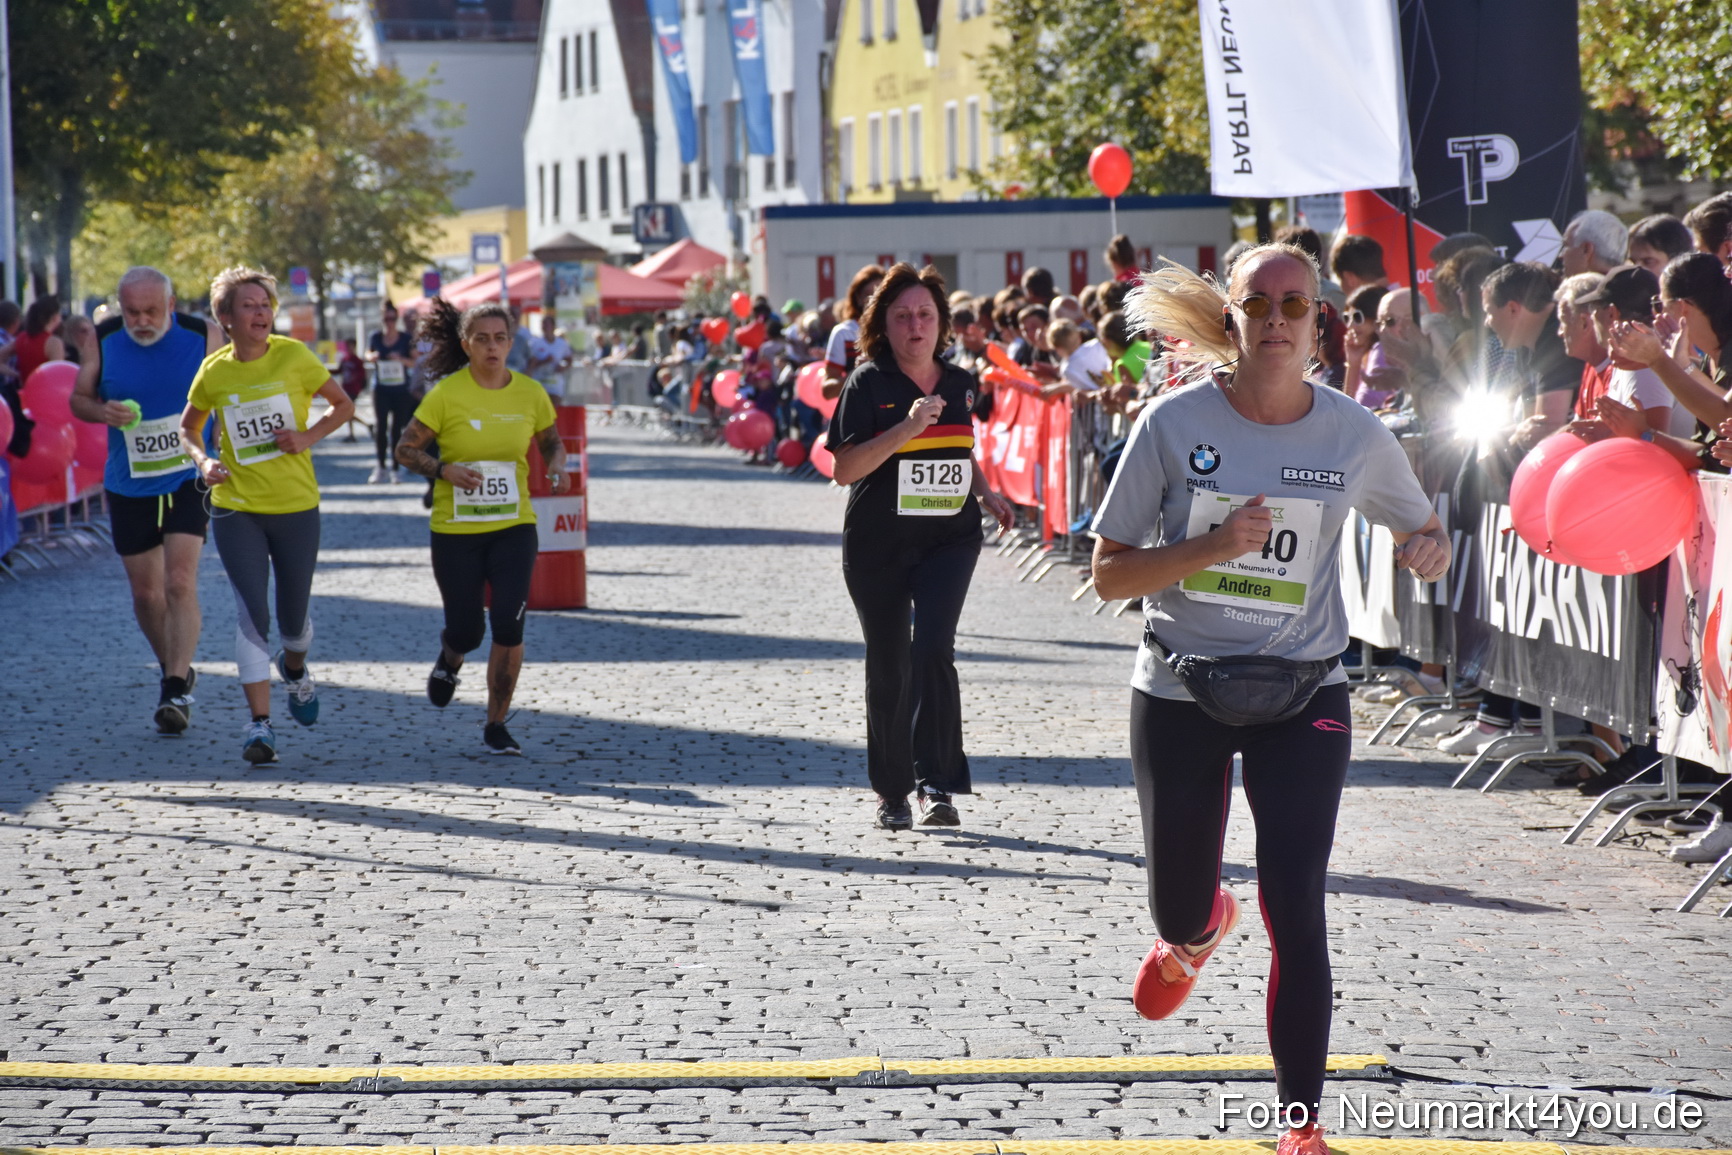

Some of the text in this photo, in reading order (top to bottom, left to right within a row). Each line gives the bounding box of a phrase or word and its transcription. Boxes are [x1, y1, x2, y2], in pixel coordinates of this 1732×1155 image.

[236, 412, 285, 439] 5153
[135, 431, 180, 454] 5208
[911, 463, 963, 485] 5128
[1186, 478, 1220, 490] PARTL
[1282, 467, 1345, 487] BOCK
[921, 497, 952, 508] Christa
[1238, 562, 1275, 574] Neumarkt
[1217, 576, 1271, 597] Andrea
[1223, 607, 1286, 629] Stadtlauf
